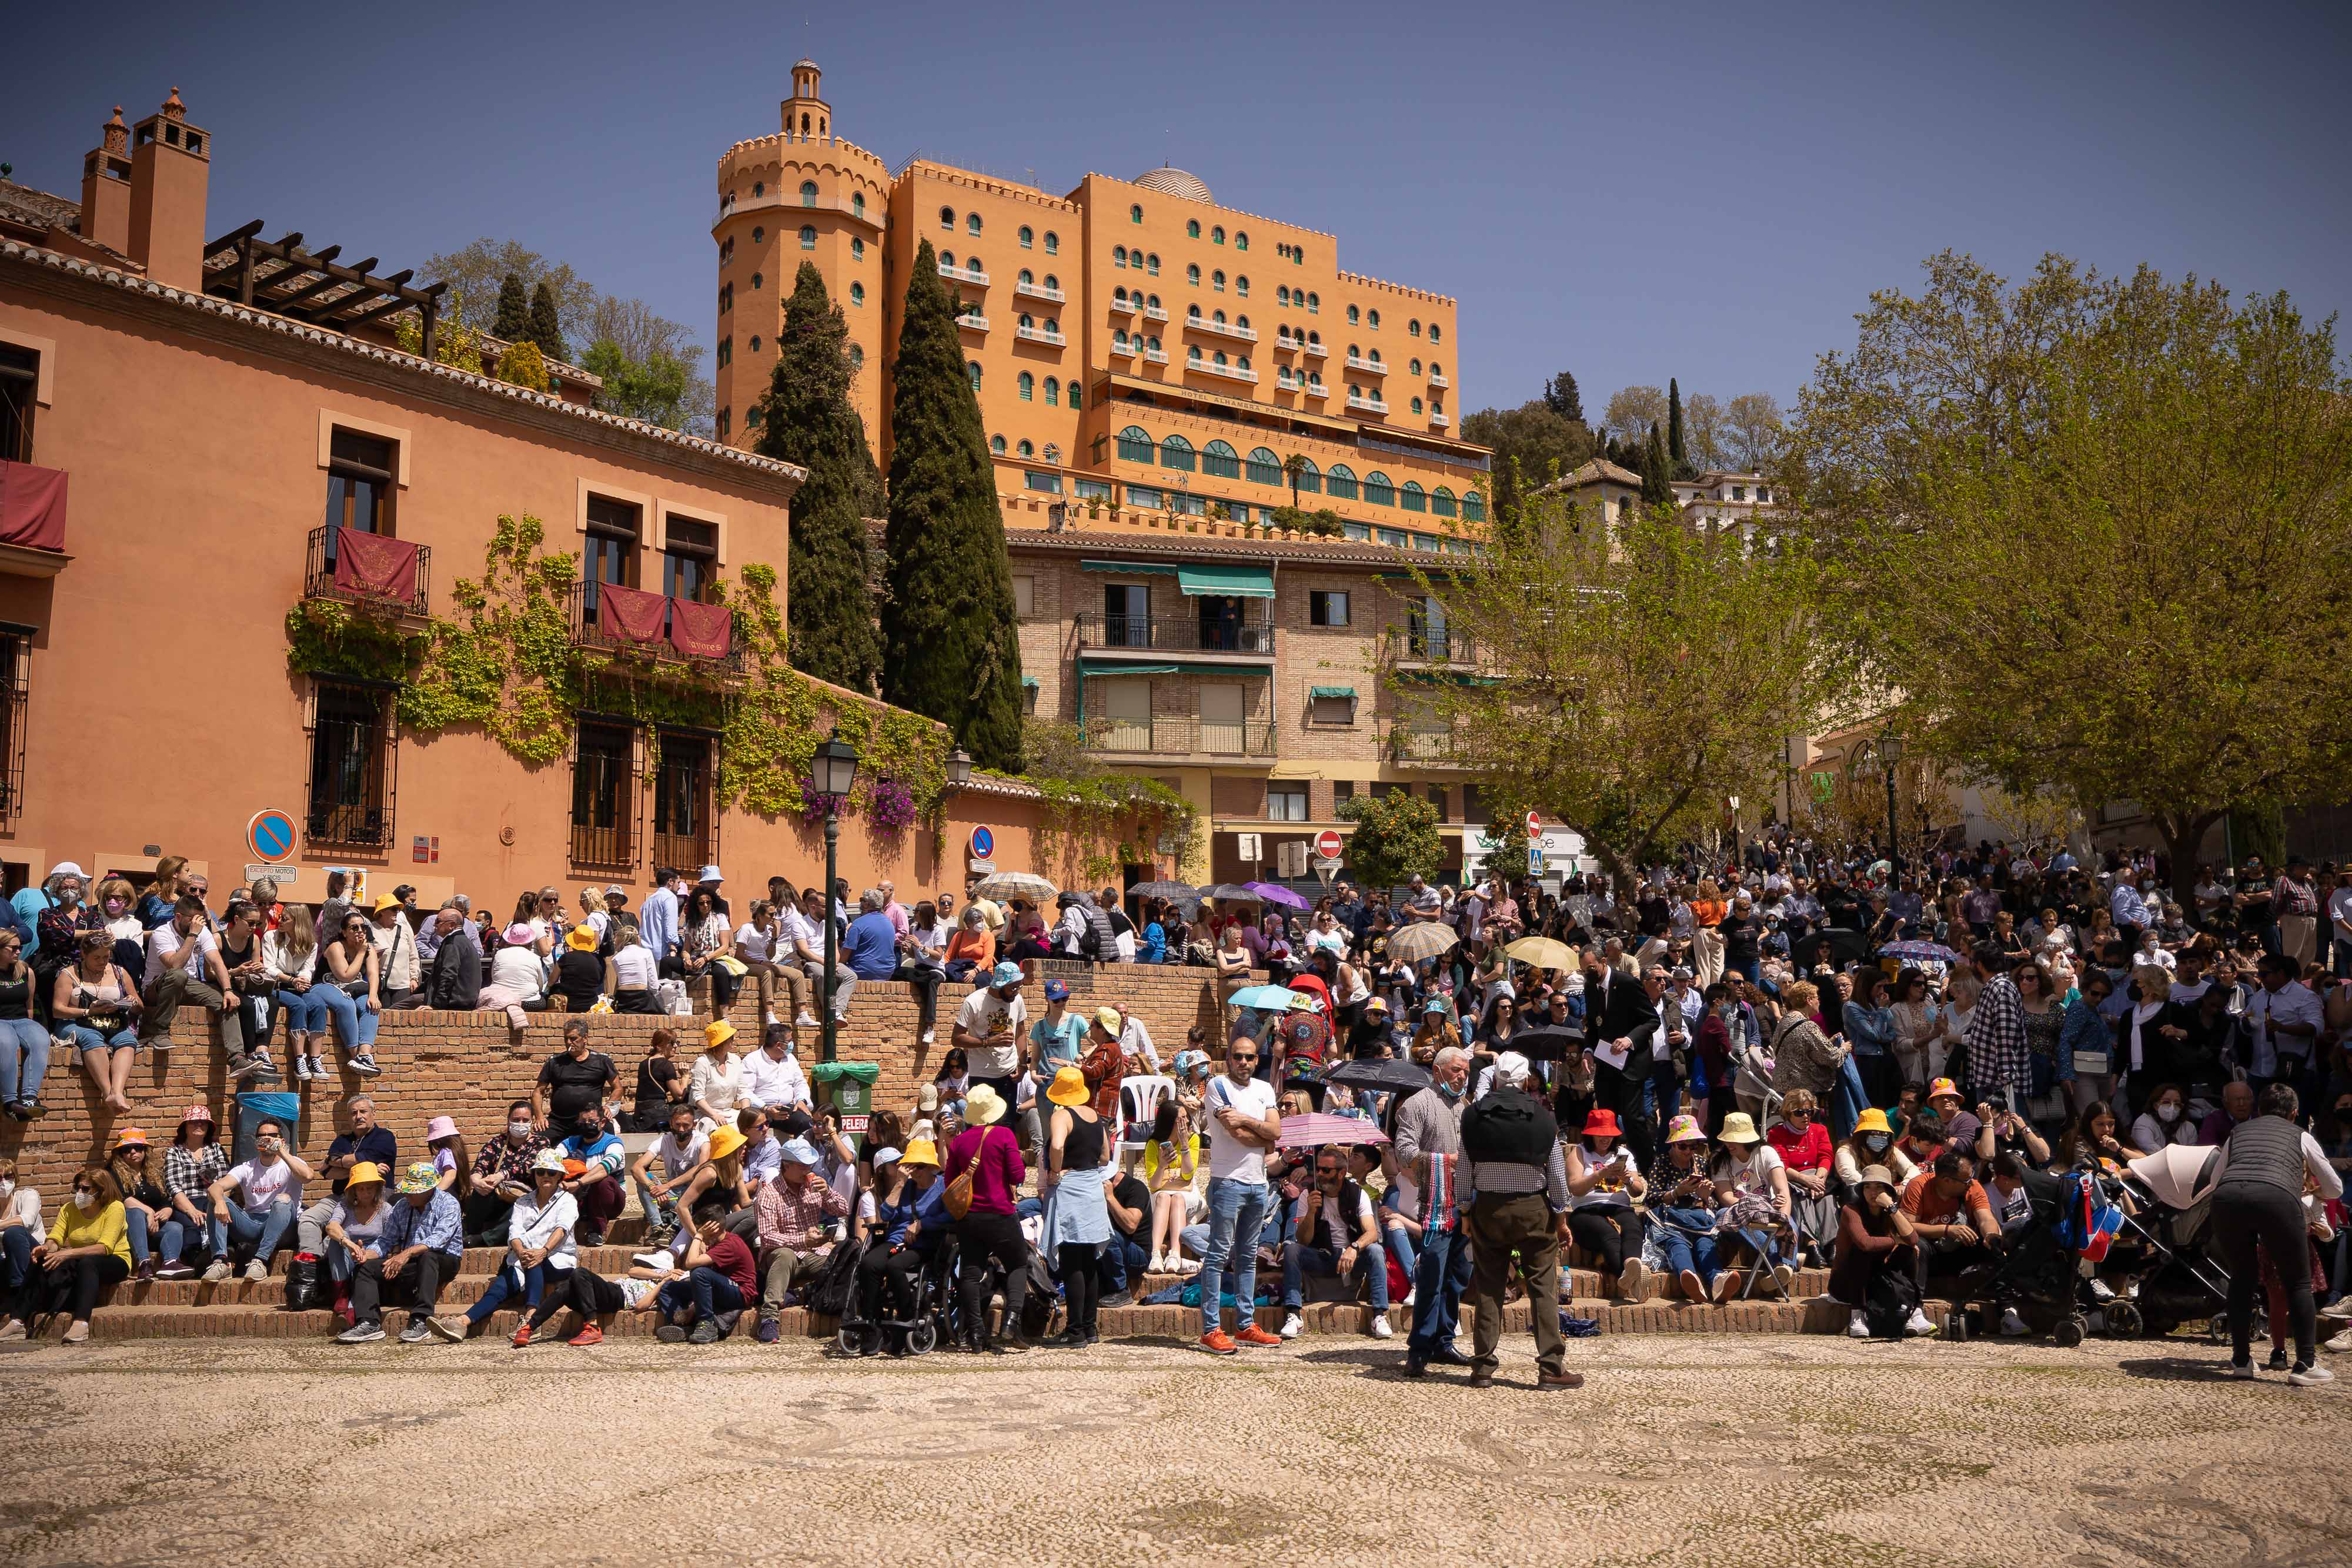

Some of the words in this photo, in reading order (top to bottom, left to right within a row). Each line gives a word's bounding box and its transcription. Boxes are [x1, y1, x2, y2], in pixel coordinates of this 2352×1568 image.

[1181, 390, 1208, 400] HOTEL
[1214, 398, 1261, 411] ALHAMBRA
[1265, 407, 1296, 419] PALACE
